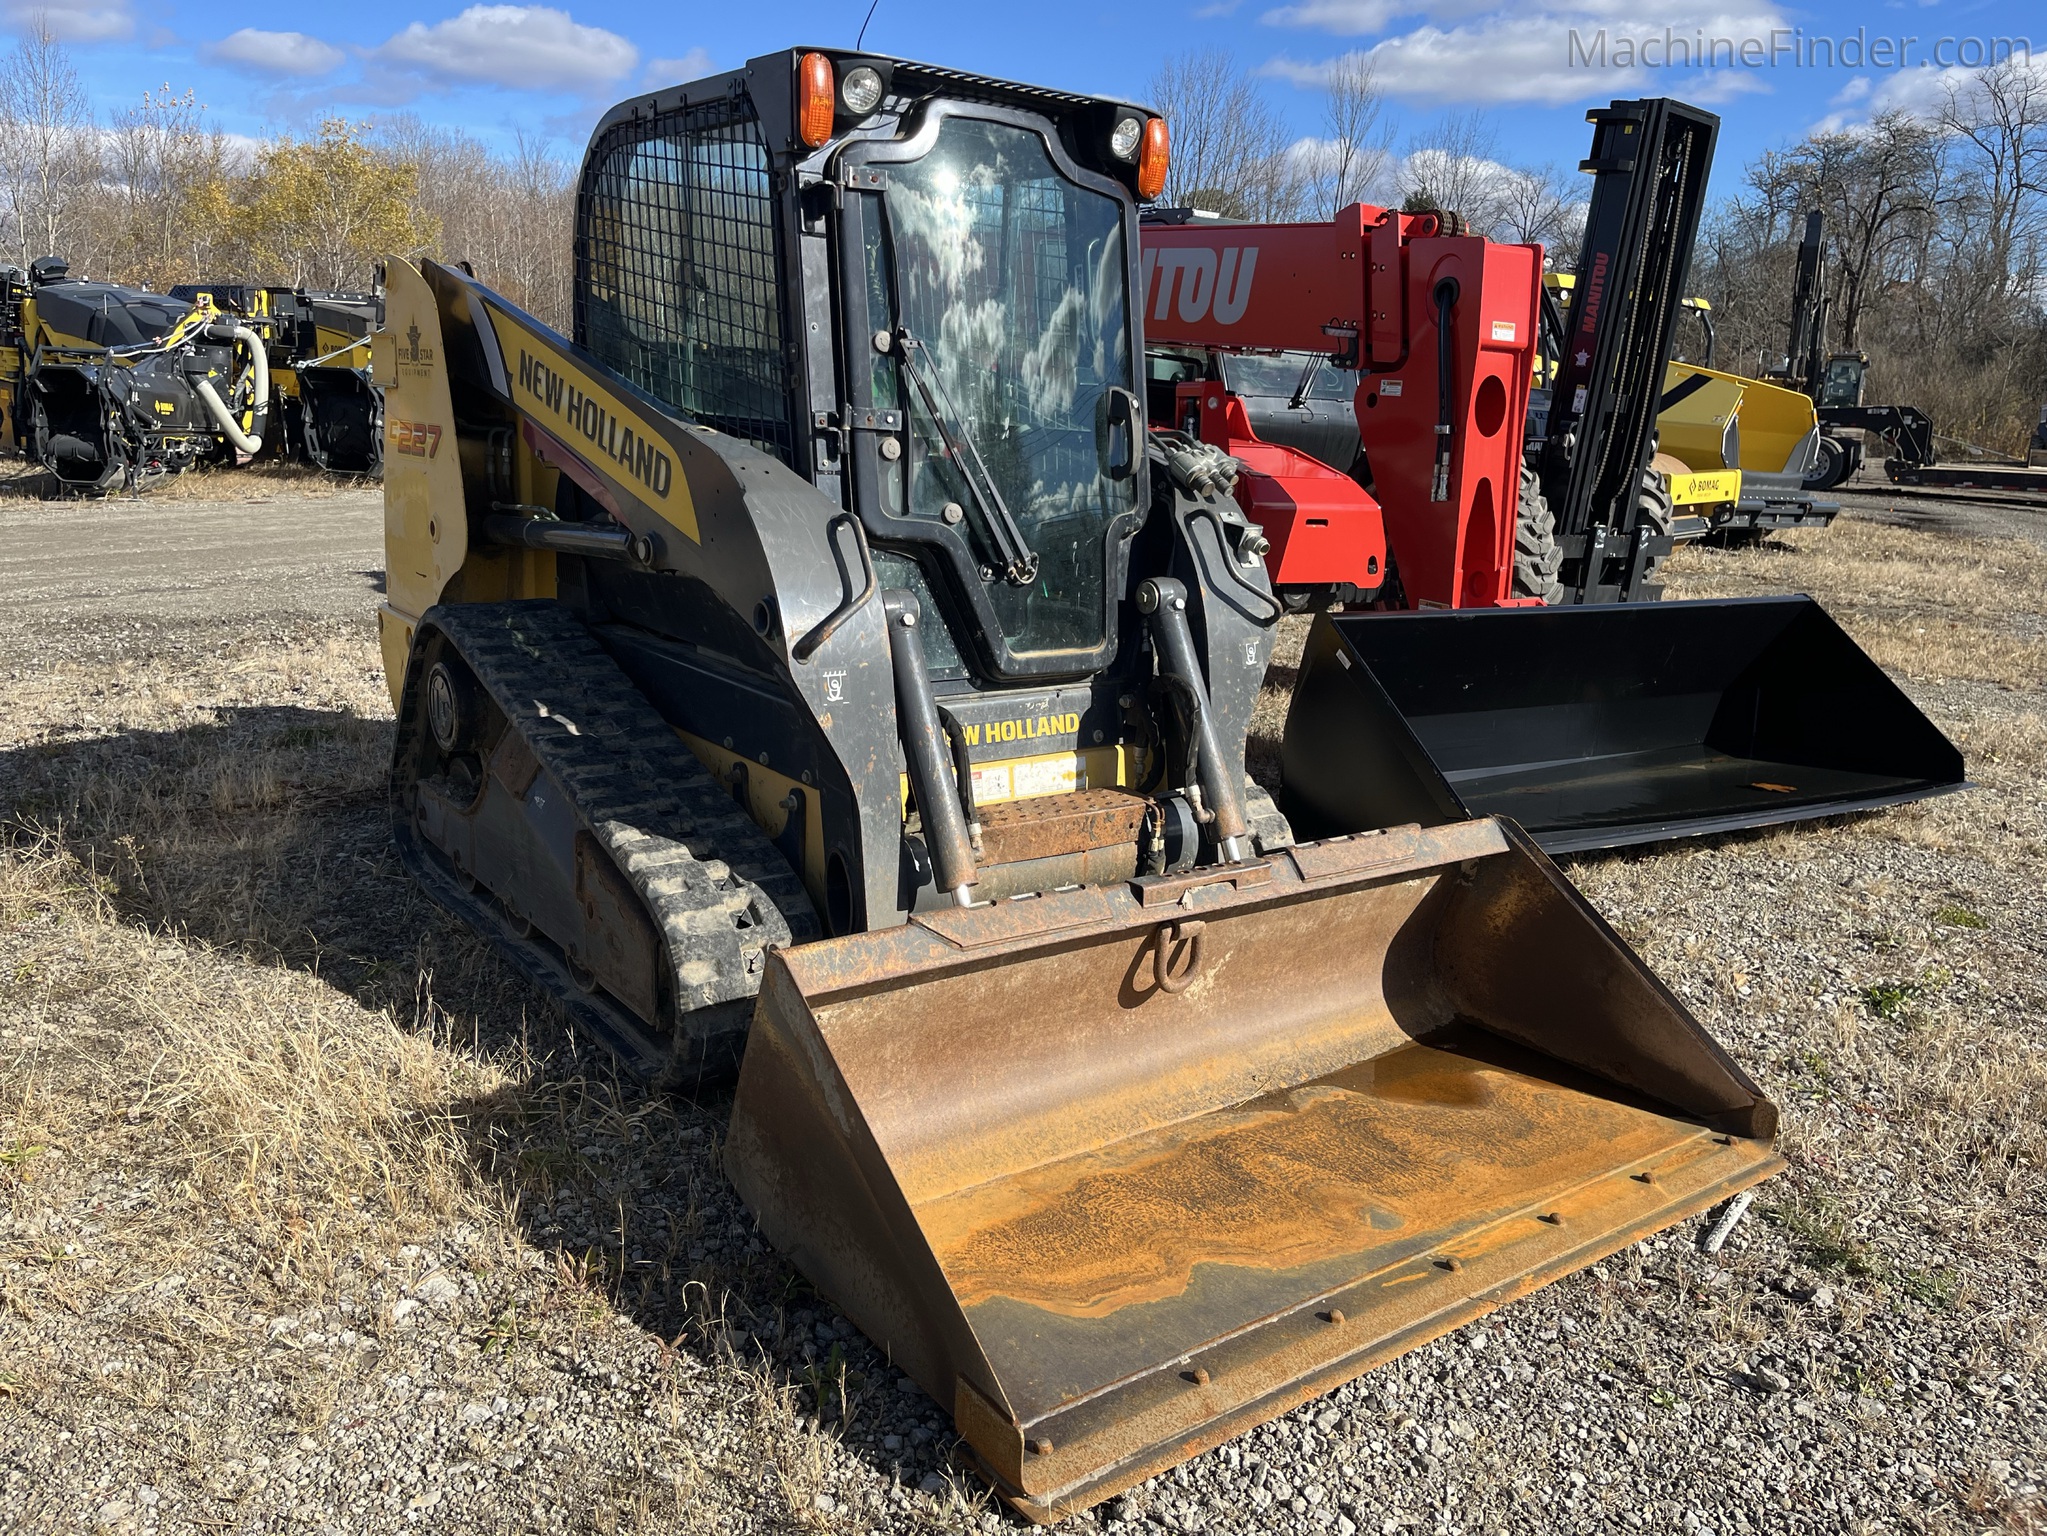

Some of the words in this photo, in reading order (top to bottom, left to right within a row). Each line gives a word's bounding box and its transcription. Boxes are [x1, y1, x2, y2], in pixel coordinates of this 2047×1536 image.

[1141, 247, 1259, 325] ITOU
[1582, 252, 1609, 334] MANITOU
[398, 348, 410, 360] FIVE
[420, 349, 433, 361] STAR
[401, 368, 431, 377] EQUIPMENT
[519, 349, 564, 415] NEW
[567, 384, 672, 500] HOLLAND
[1697, 479, 1720, 492] BOMAG
[985, 713, 1080, 744] HOLLAND
